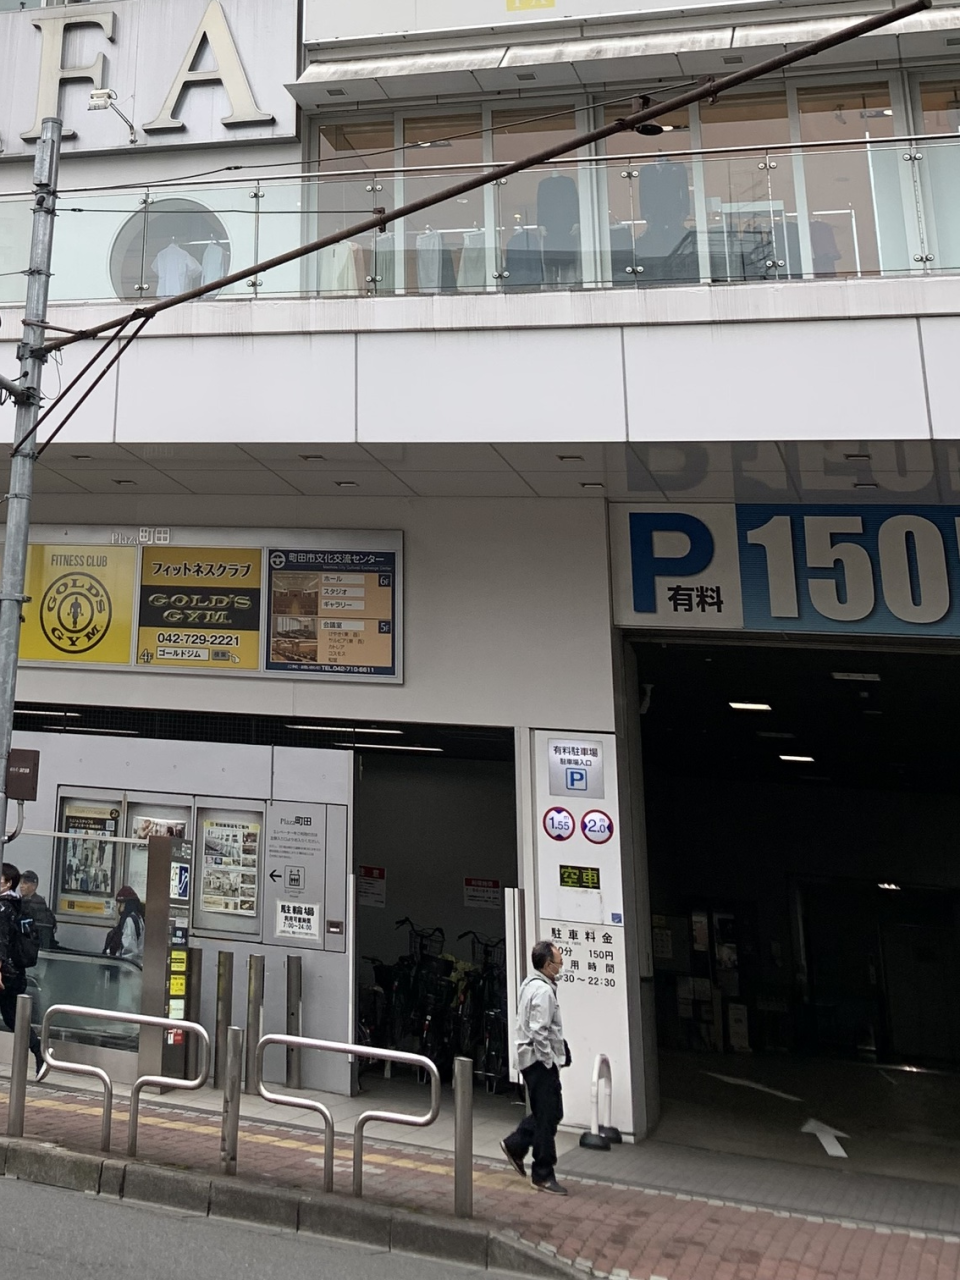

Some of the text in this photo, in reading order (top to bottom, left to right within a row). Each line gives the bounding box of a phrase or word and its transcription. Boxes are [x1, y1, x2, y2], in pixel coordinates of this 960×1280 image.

[51, 554, 108, 568] FITNESS CLUB
[288, 552, 384, 564] 町田市文化交流センター
[628, 512, 715, 614] P
[152, 562, 252, 578] フィットネスクラブ
[747, 514, 960, 624] 150
[380, 575, 389, 586] 6F
[47, 578, 106, 614] GOLD'S
[323, 588, 348, 596] スタジオ
[667, 585, 724, 613] 有料
[148, 593, 253, 609] GOLD'S
[323, 621, 342, 629] 会議室
[380, 623, 389, 632] 5F
[50, 623, 101, 647] GYM
[157, 632, 239, 646] 042-729-2221
[140, 648, 154, 664] 4F
[158, 648, 201, 658] ゴールドジム
[553, 745, 599, 758] 有料駐車場
[560, 757, 592, 767] 駐車場入口
[569, 770, 584, 788] P
[548, 816, 570, 831] 1.55
[588, 819, 607, 834] 2.0
[560, 868, 599, 888] 空車
[281, 904, 315, 916] 駐輪場
[551, 927, 613, 945] 駐車料金
[589, 949, 614, 961] 150円
[570, 959, 615, 974] 用時間
